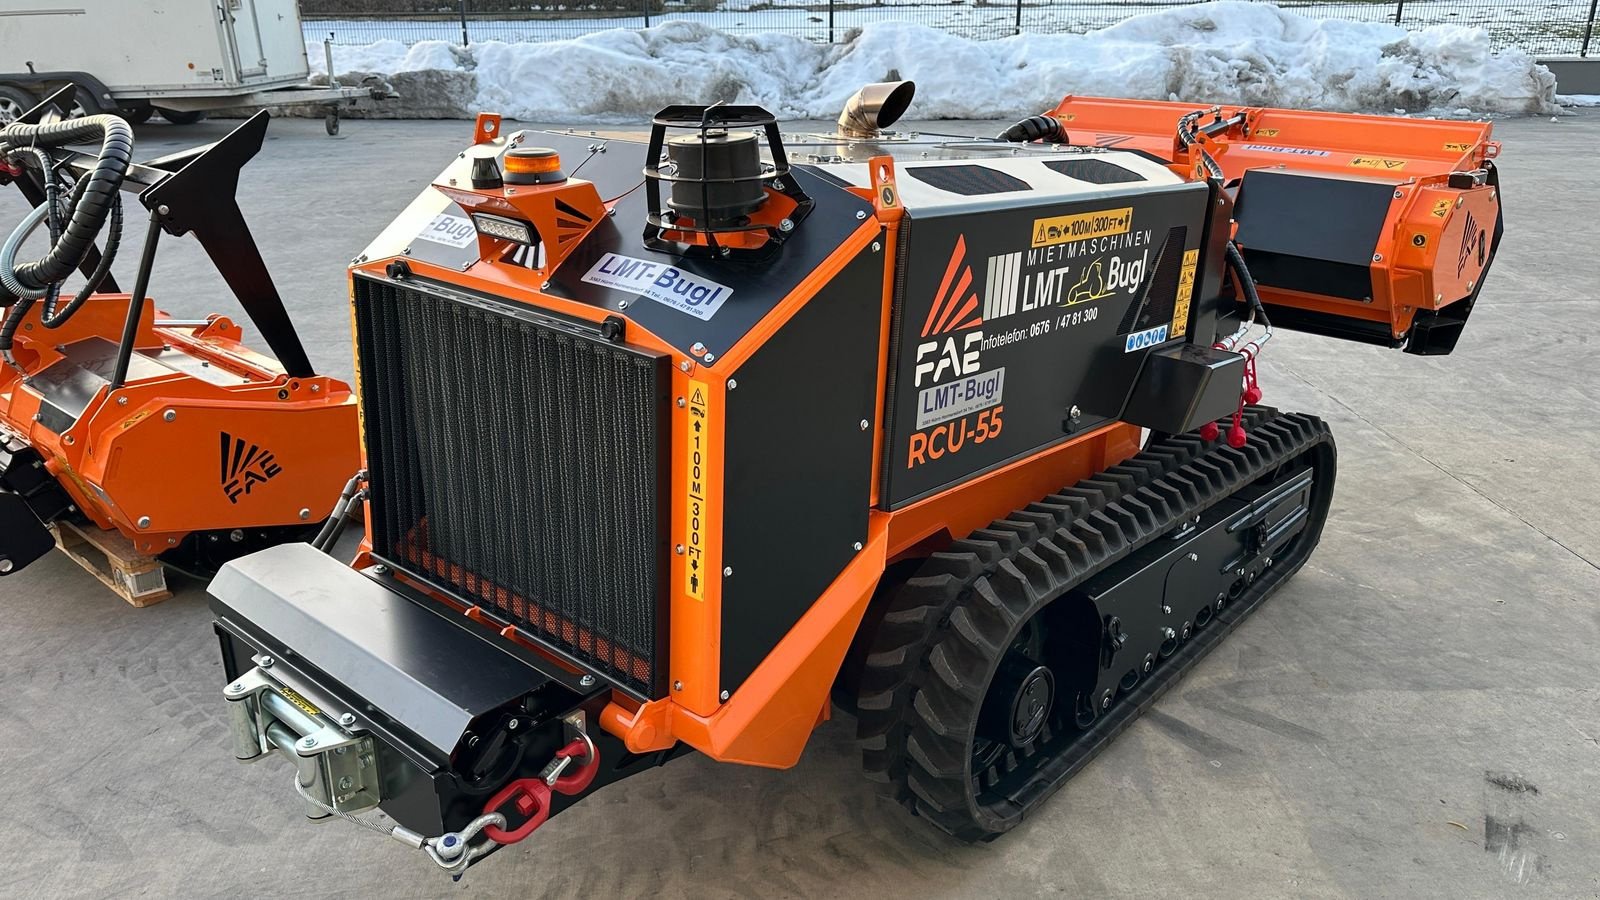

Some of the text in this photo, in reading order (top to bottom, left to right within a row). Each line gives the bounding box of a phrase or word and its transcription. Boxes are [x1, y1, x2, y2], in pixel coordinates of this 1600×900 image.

[1027, 229, 1152, 266] MIETMASCHINEN
[1071, 216, 1118, 236] 100M/300FT
[598, 256, 723, 306] LMT-Bugl
[1022, 249, 1148, 312] LMT Bugl
[981, 328, 1028, 351] Infotelefon:
[1030, 320, 1051, 337] 0676
[1060, 314, 1071, 328] 47
[1072, 311, 1082, 325] 81
[1083, 307, 1098, 322] 300
[915, 331, 983, 387] FAE
[924, 371, 1000, 414] LMT-Bugl
[908, 405, 1004, 469] RCU-55
[224, 454, 283, 505] FAE
